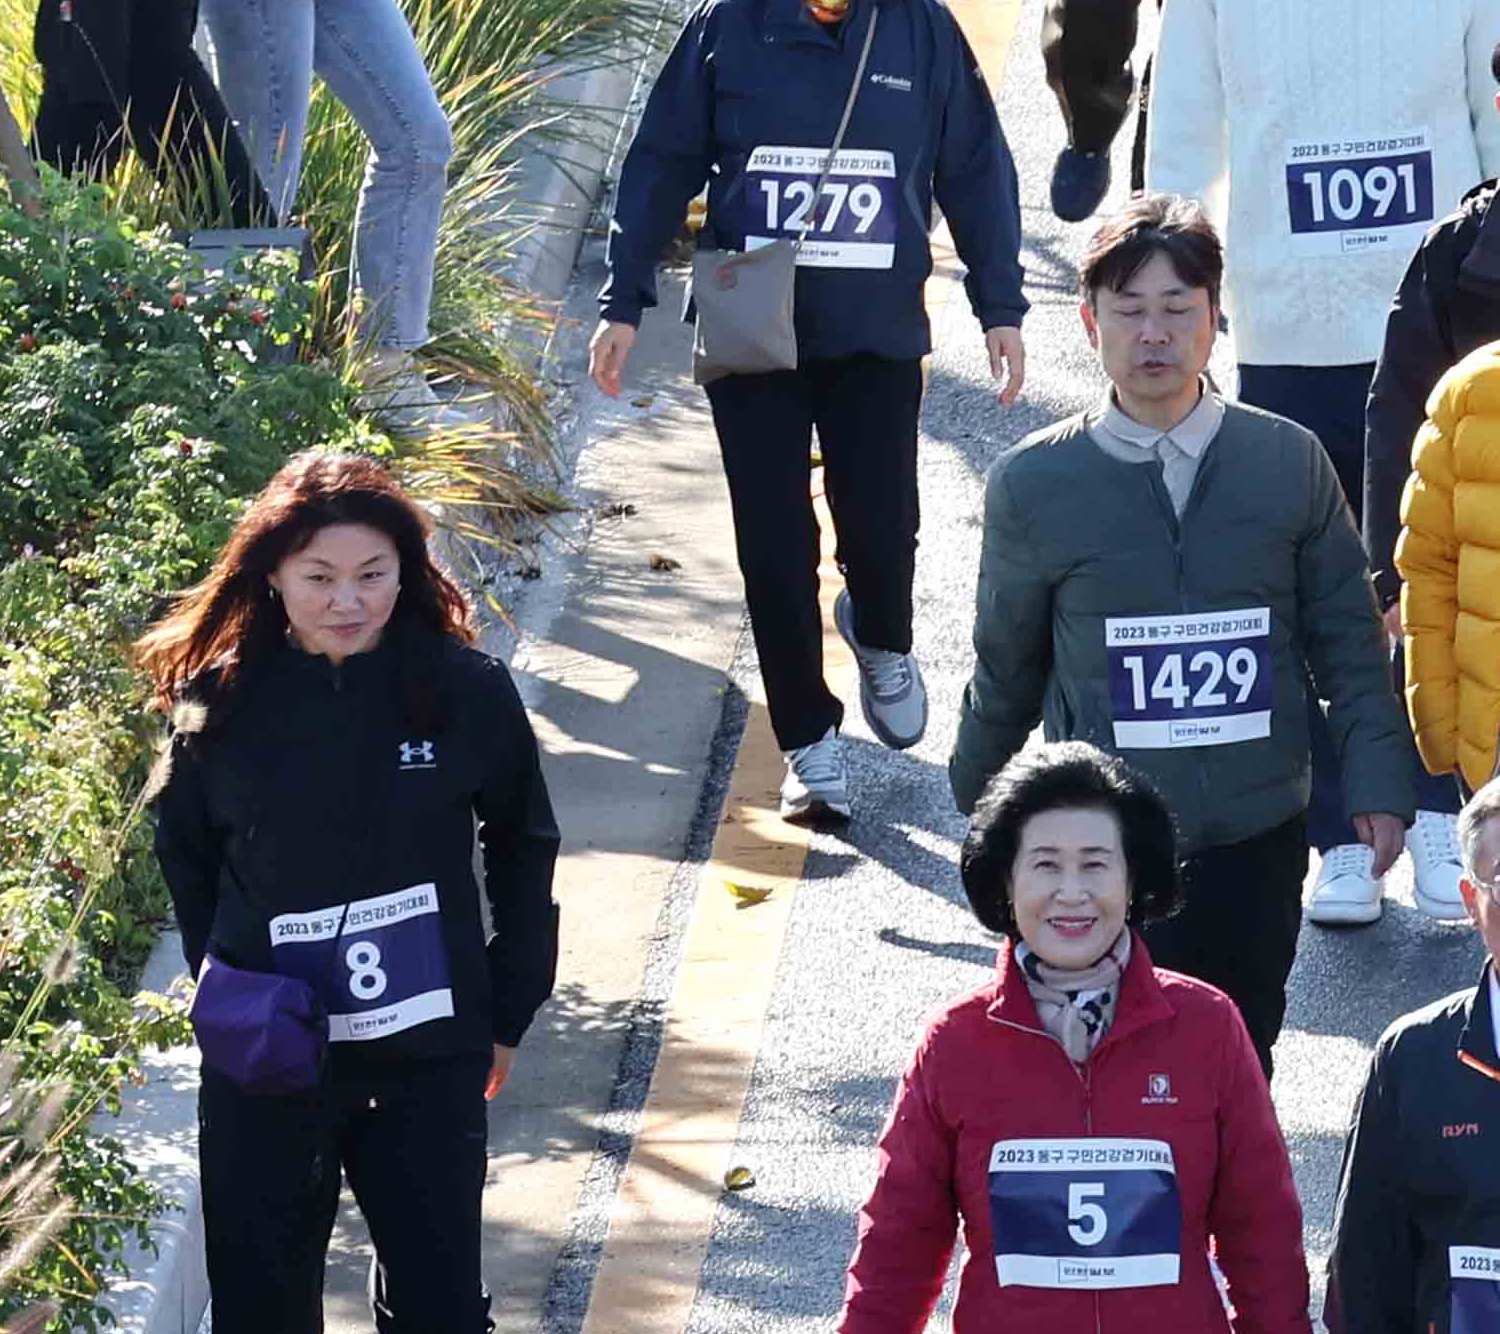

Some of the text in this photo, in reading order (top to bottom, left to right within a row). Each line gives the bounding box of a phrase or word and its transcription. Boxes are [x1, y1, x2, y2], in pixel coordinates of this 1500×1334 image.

[1291, 144, 1319, 158] 2023
[752, 153, 781, 166] 2023
[1302, 163, 1416, 223] 1091
[760, 179, 883, 234] 1279
[1113, 626, 1146, 640] 2023
[1122, 647, 1258, 710] 1429
[276, 922, 310, 937] 2023
[346, 940, 388, 1000] 8
[998, 1149, 1035, 1164] 2023
[1067, 1182, 1108, 1246] 5
[1459, 1256, 1491, 1272] 2023
